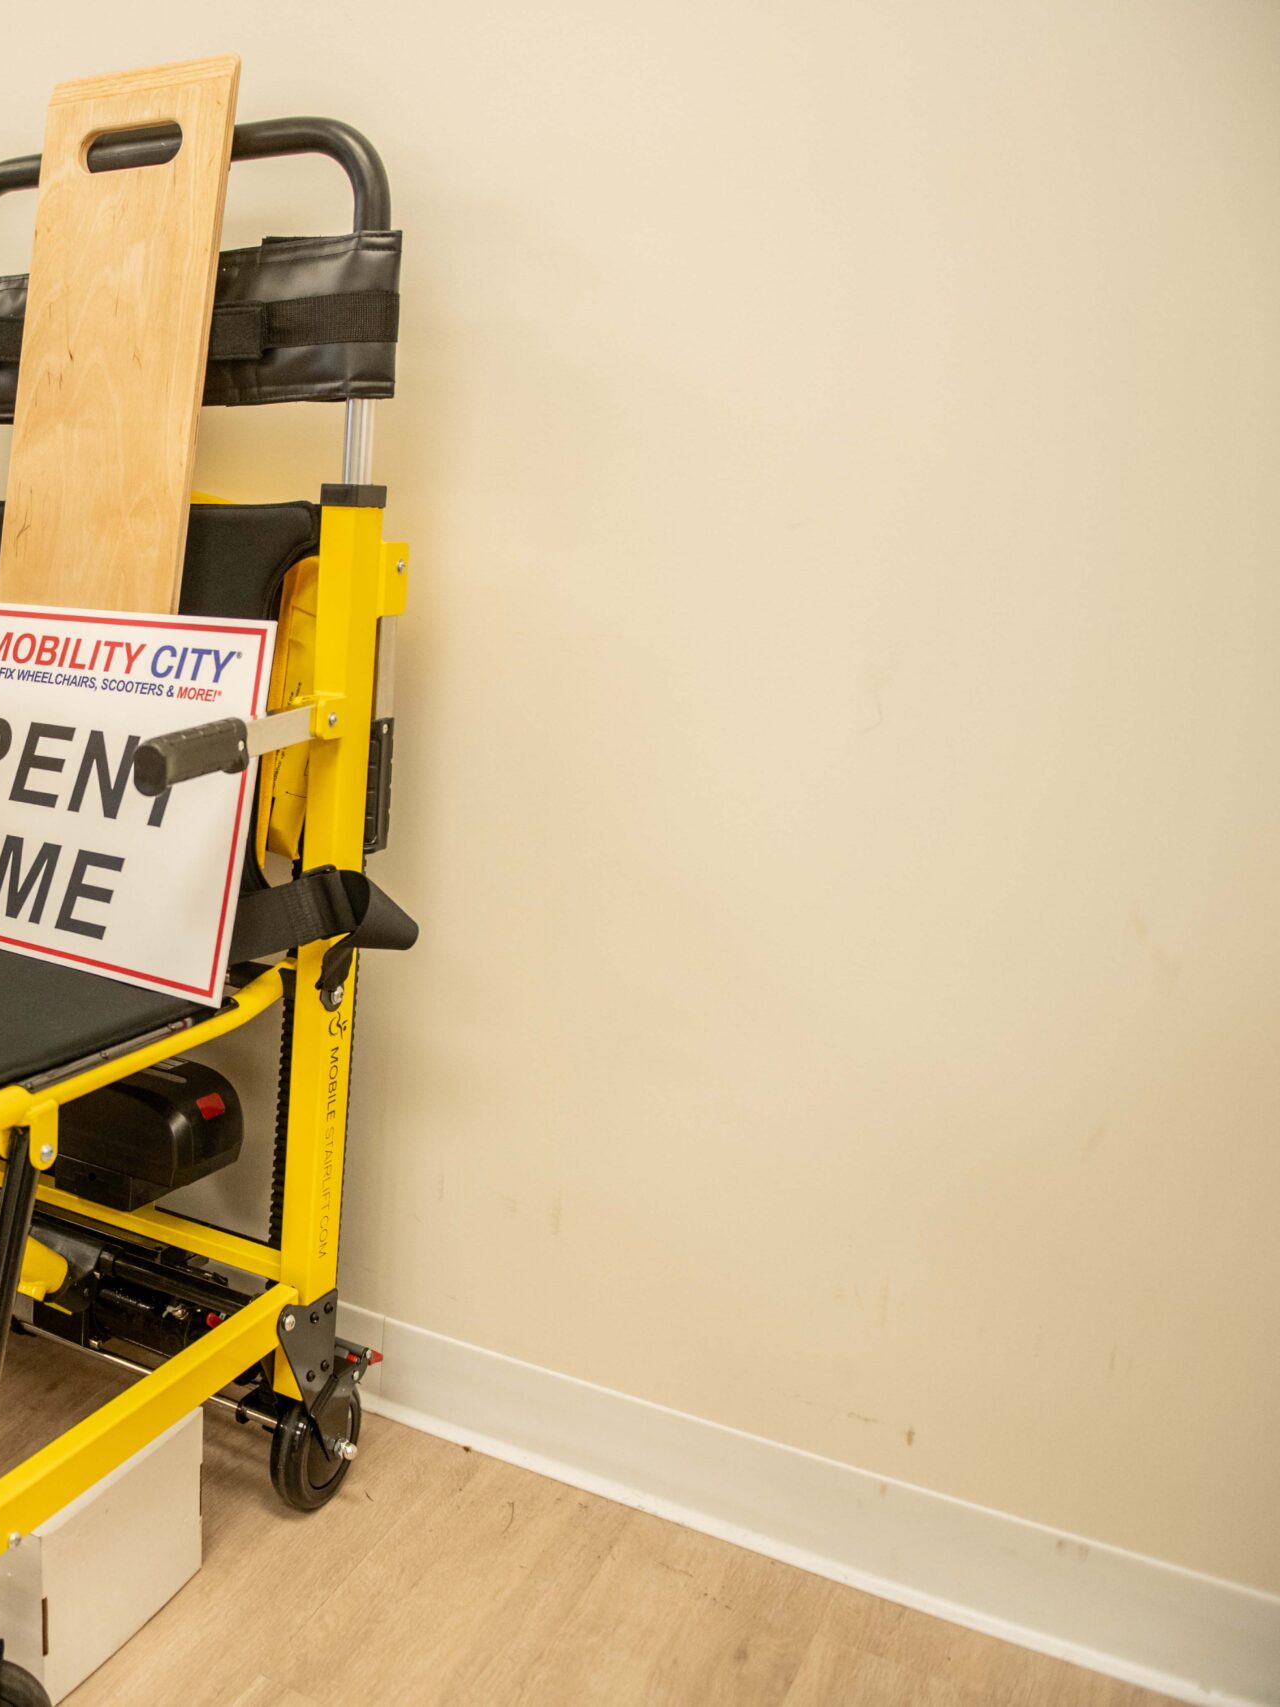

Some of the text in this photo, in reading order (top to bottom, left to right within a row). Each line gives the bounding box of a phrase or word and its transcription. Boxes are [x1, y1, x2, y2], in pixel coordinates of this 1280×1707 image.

[17, 668, 98, 691] WHEELCHAIRS,
[101, 678, 165, 696] SCOOTERS
[166, 685, 175, 698] &
[326, 1046, 340, 1122] MOBILE
